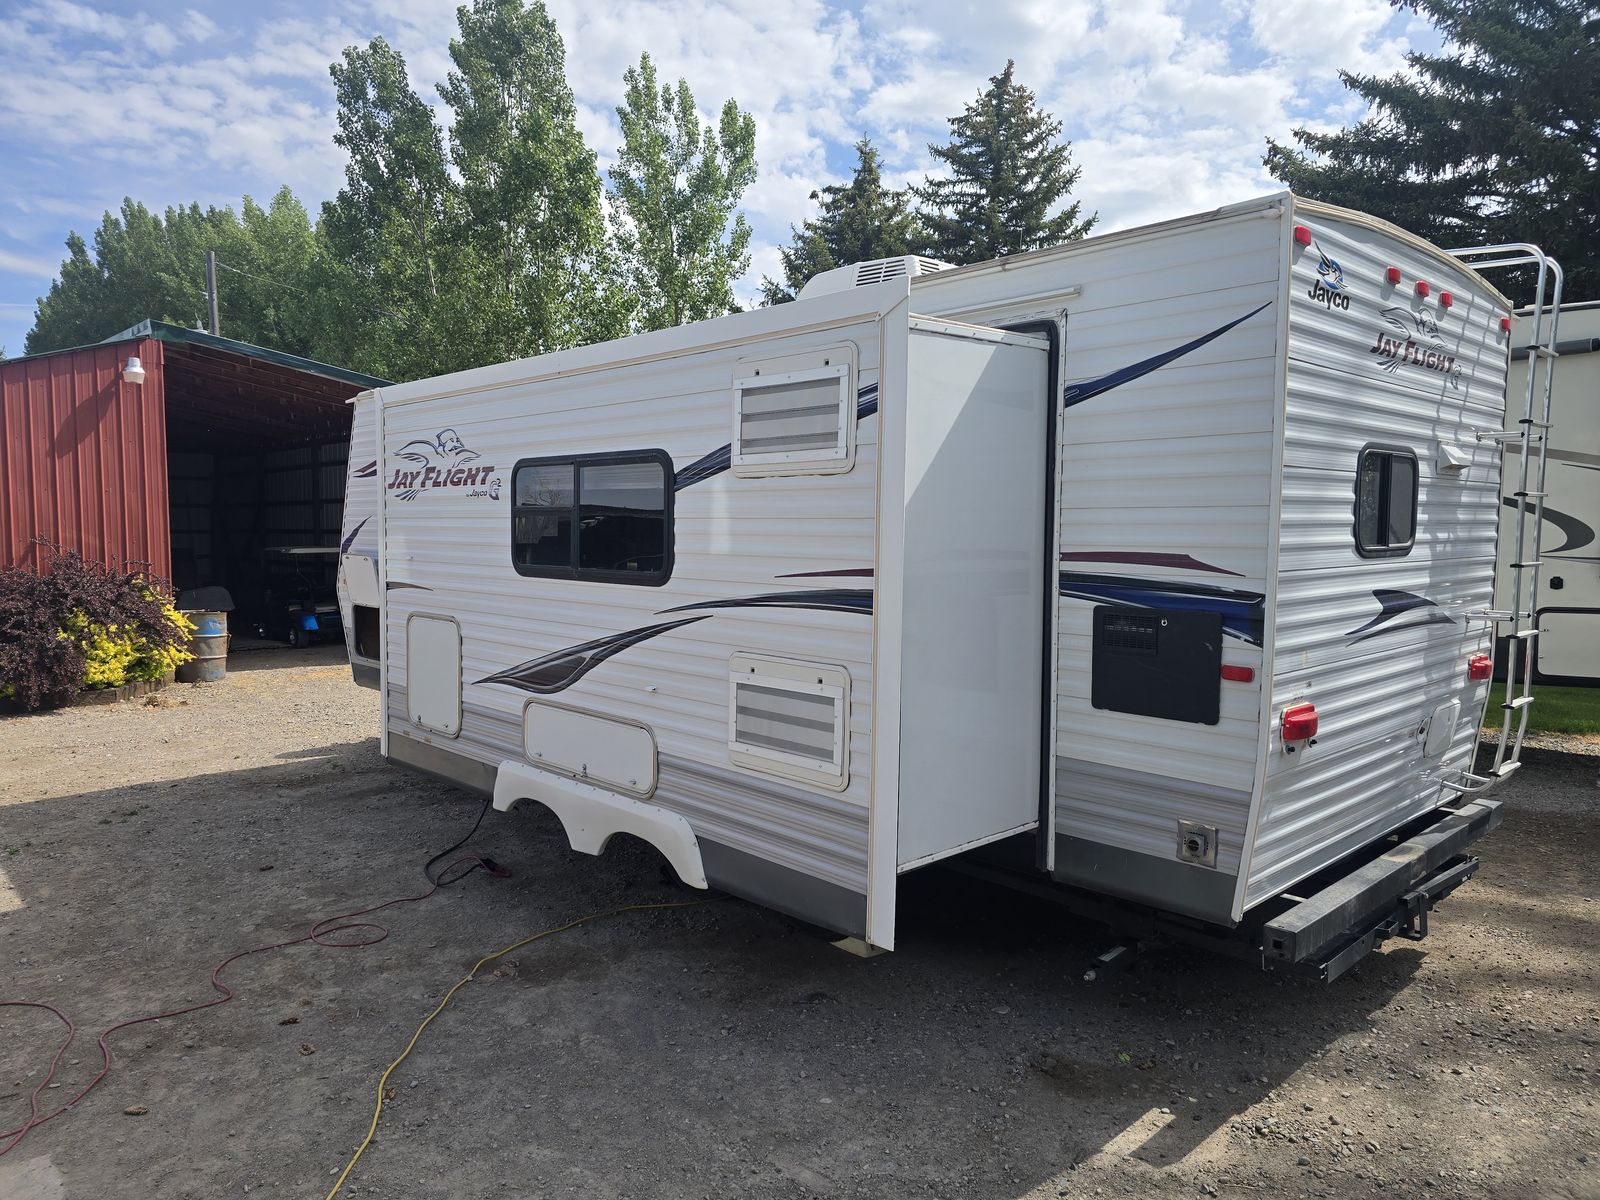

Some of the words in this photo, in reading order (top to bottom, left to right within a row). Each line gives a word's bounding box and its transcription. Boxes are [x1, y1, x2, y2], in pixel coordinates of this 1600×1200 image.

[1307, 279, 1350, 311] Jayco
[1370, 332, 1403, 359] JAY
[1401, 341, 1456, 373] FLIGHT
[388, 469, 421, 490] JAY
[421, 466, 495, 488] FLIGHT
